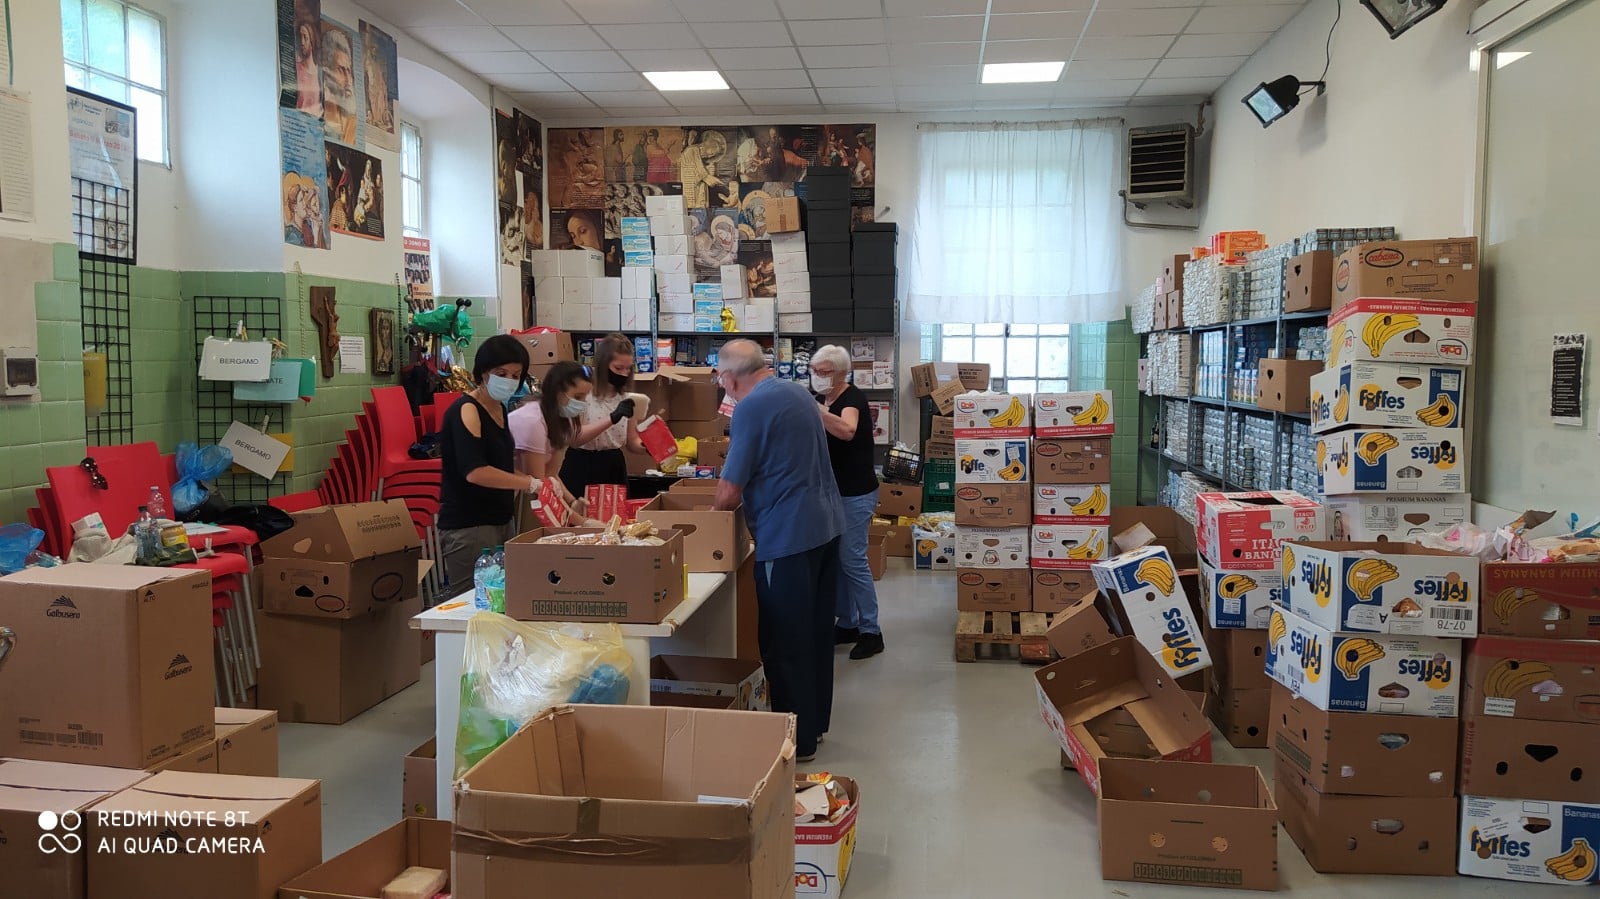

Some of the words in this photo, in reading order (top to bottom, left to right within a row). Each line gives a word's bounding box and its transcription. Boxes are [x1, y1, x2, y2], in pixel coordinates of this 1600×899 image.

[1440, 344, 1462, 356] Dole
[234, 439, 272, 460] BERGAMO
[1494, 567, 1555, 578] BANANAS
[1561, 567, 1600, 578] MIUM
[46, 608, 80, 619] Galbusera
[1437, 619, 1466, 631] 07-78
[164, 665, 193, 680] Galbusera
[1330, 699, 1366, 709] Bananas
